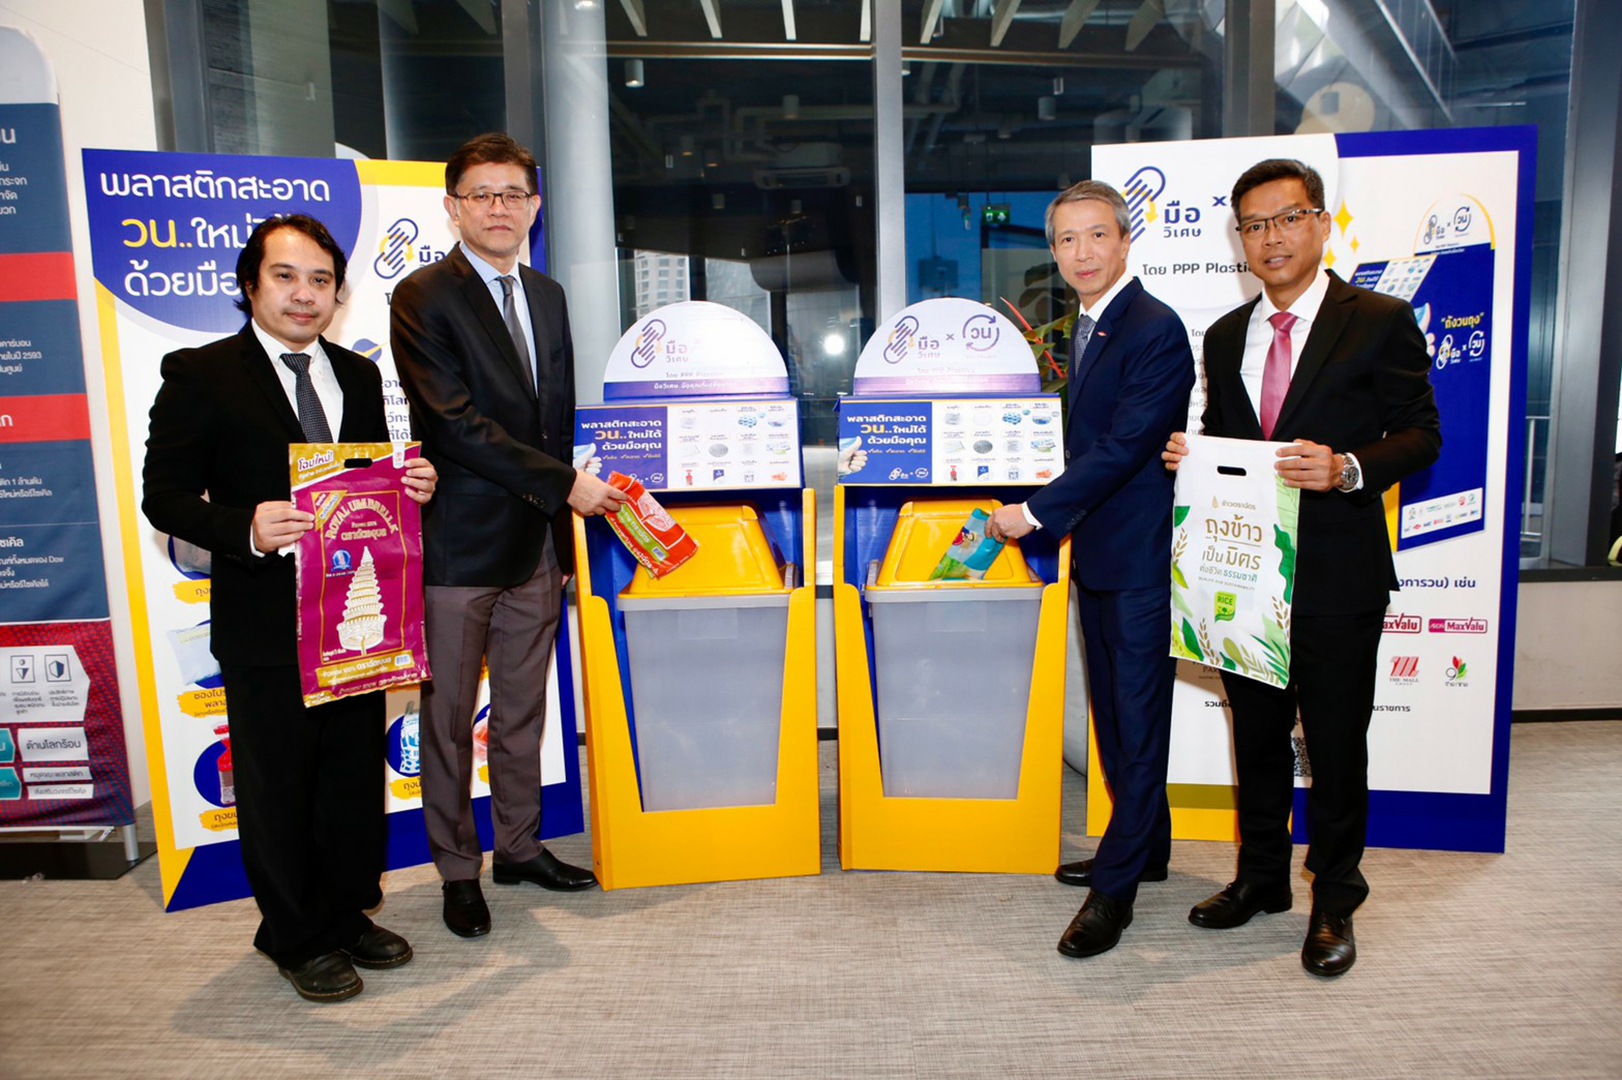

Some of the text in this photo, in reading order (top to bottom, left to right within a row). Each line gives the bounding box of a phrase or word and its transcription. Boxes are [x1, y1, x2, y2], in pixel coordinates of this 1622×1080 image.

[100, 170, 330, 201] พลาสติกสะอาด
[1163, 200, 1201, 224] มือ
[1457, 214, 1467, 225] วน
[1163, 227, 1202, 239] วิเศษ
[1142, 263, 1167, 276] โดย
[1172, 263, 1200, 275] PPP
[971, 327, 992, 339] วน
[666, 340, 688, 354] มือ
[918, 336, 940, 350] มือ
[23, 351, 42, 359] 2593
[581, 420, 662, 429] พลาสติกสะอาด
[846, 414, 927, 423] พลาสติกสะอาด
[602, 441, 662, 451] ด้วยมือคุณ
[867, 435, 927, 447] ด้วยมือคุณ
[325, 505, 351, 539] ROYAL
[347, 497, 399, 535] UMBRELLA
[1205, 514, 1263, 543] ถุงข้าว
[1202, 545, 1262, 571] เป็น มิตร
[1223, 570, 1258, 583] ธรรมชาติ
[1454, 576, 1476, 588] เช่น
[1217, 595, 1233, 605] RICE
[1383, 612, 1418, 630] axValu
[1447, 617, 1485, 631] MaxValu
